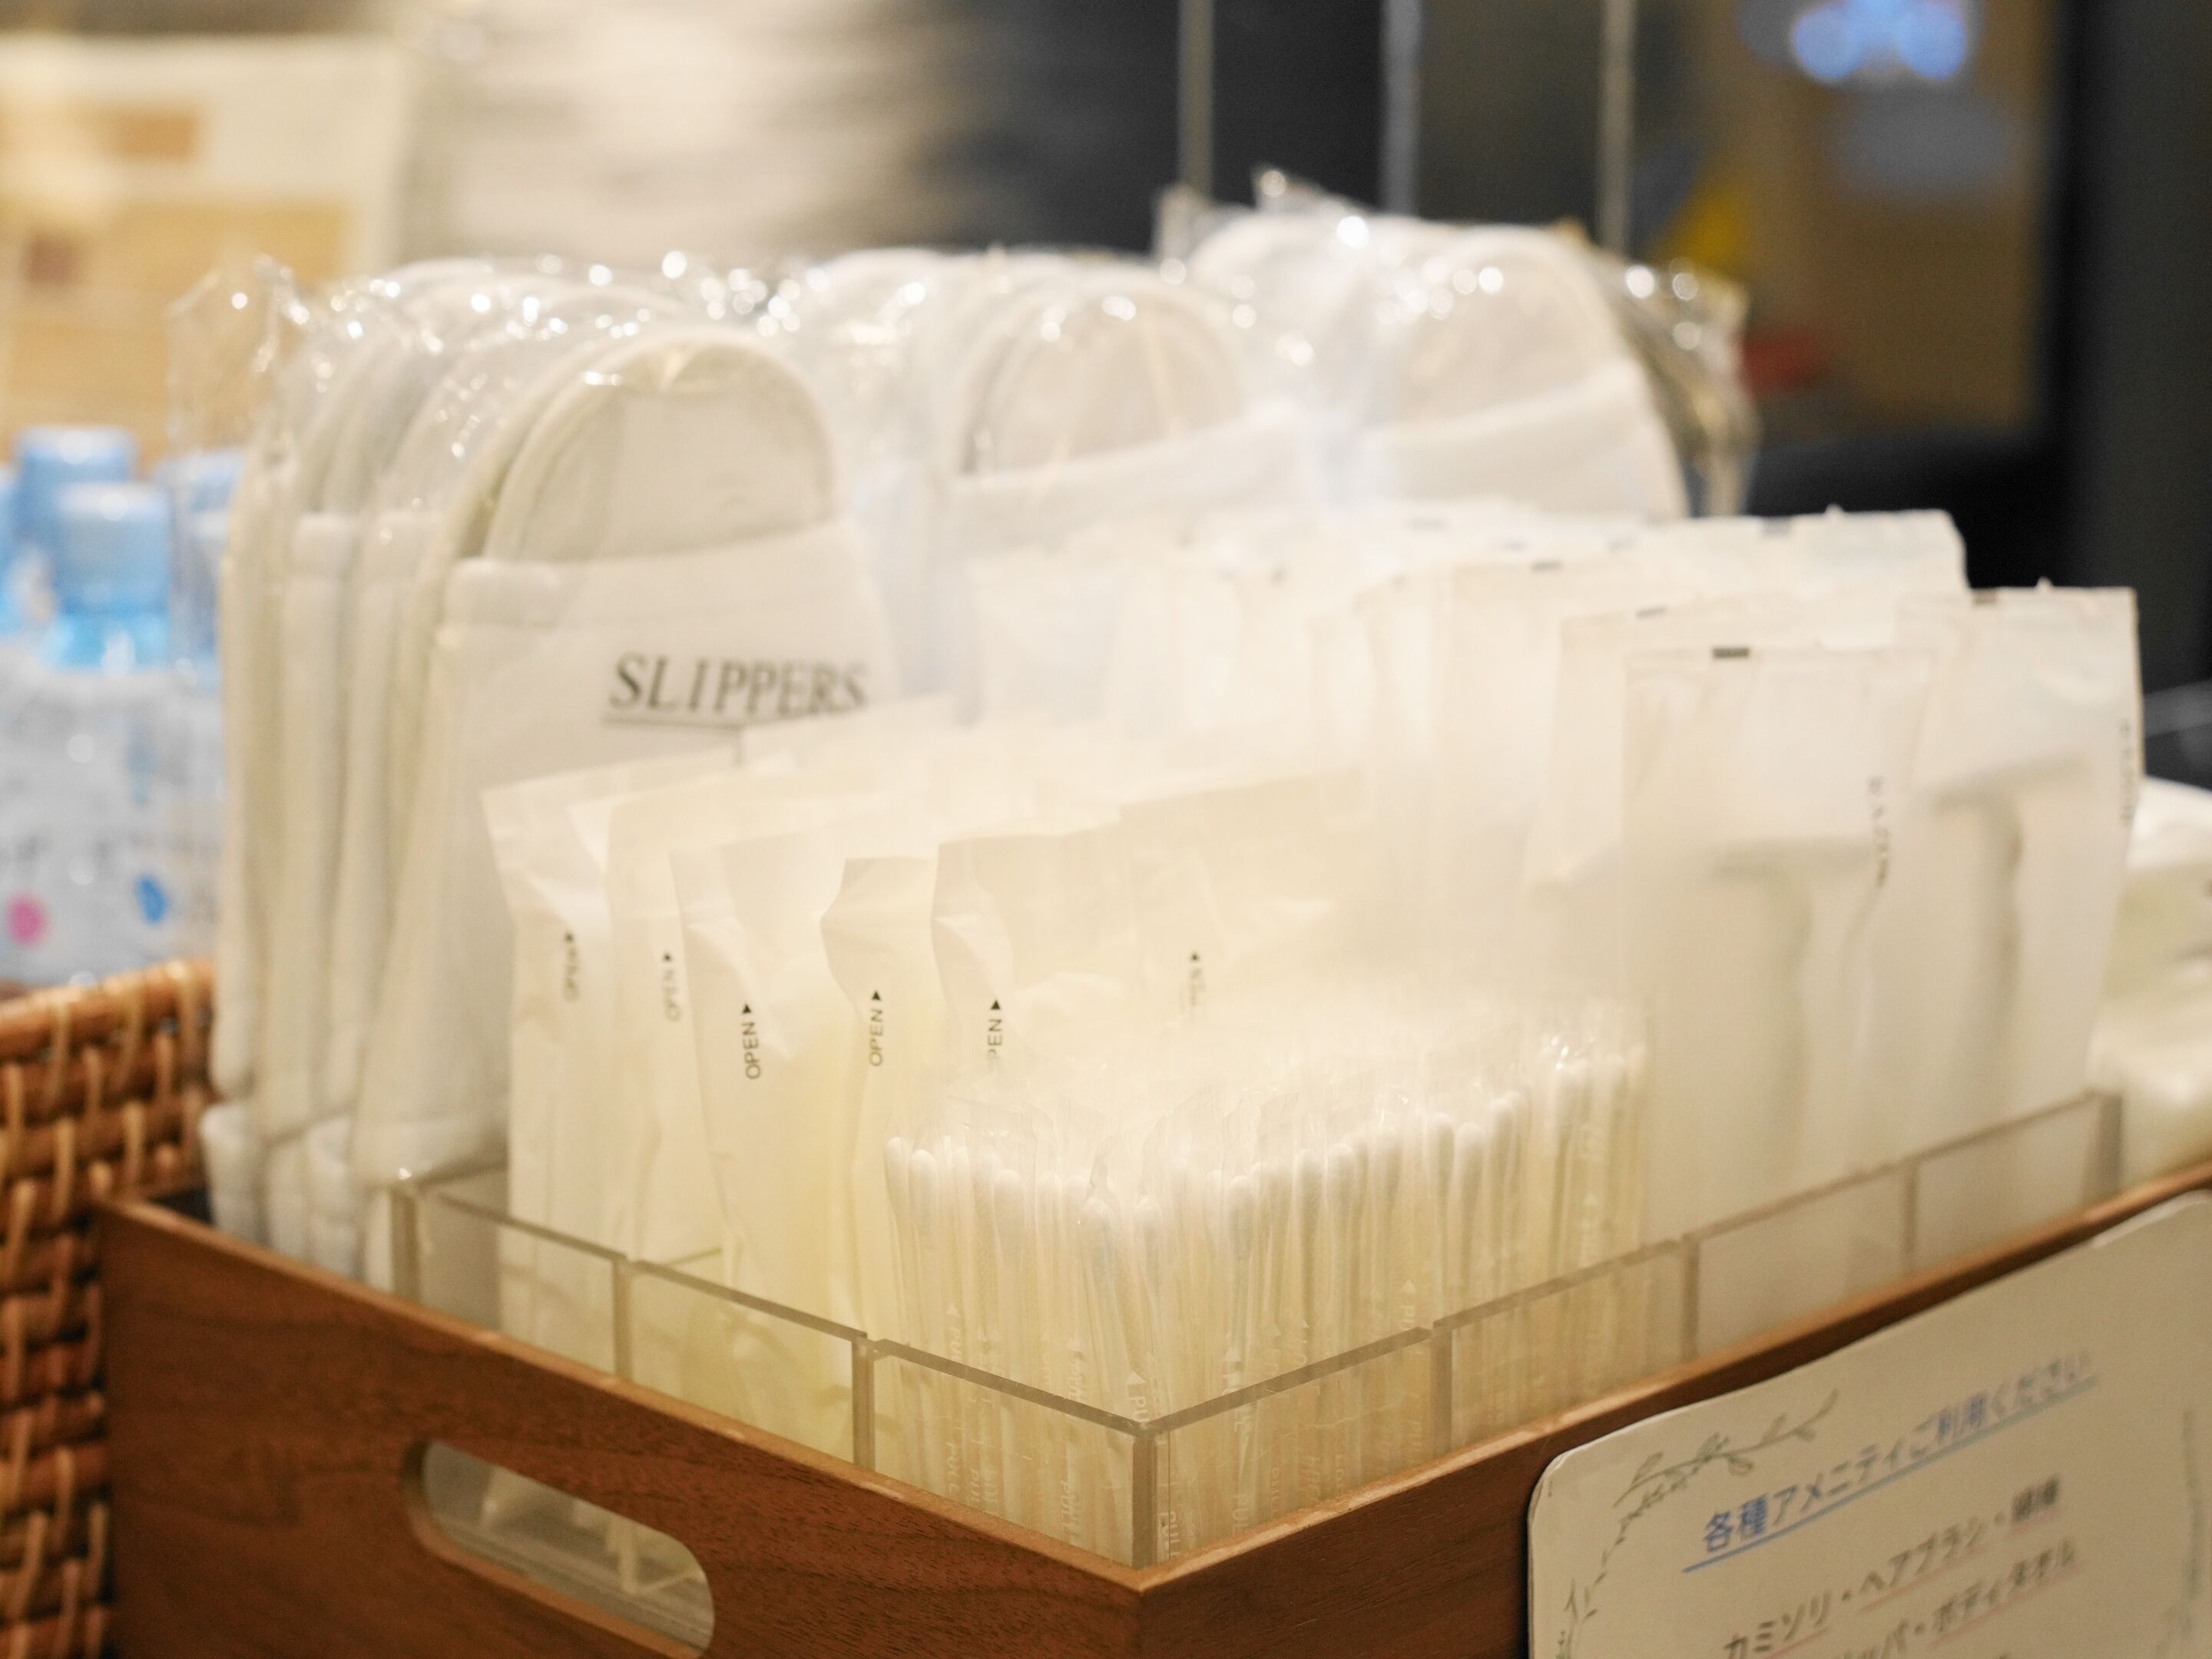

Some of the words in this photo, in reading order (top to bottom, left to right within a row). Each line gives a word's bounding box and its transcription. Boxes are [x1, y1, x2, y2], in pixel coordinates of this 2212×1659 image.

[609, 650, 868, 716] SLIPPERS
[741, 1021, 761, 1079] OPEN
[869, 1008, 884, 1067] OPEN
[986, 1018, 1002, 1071] PEN
